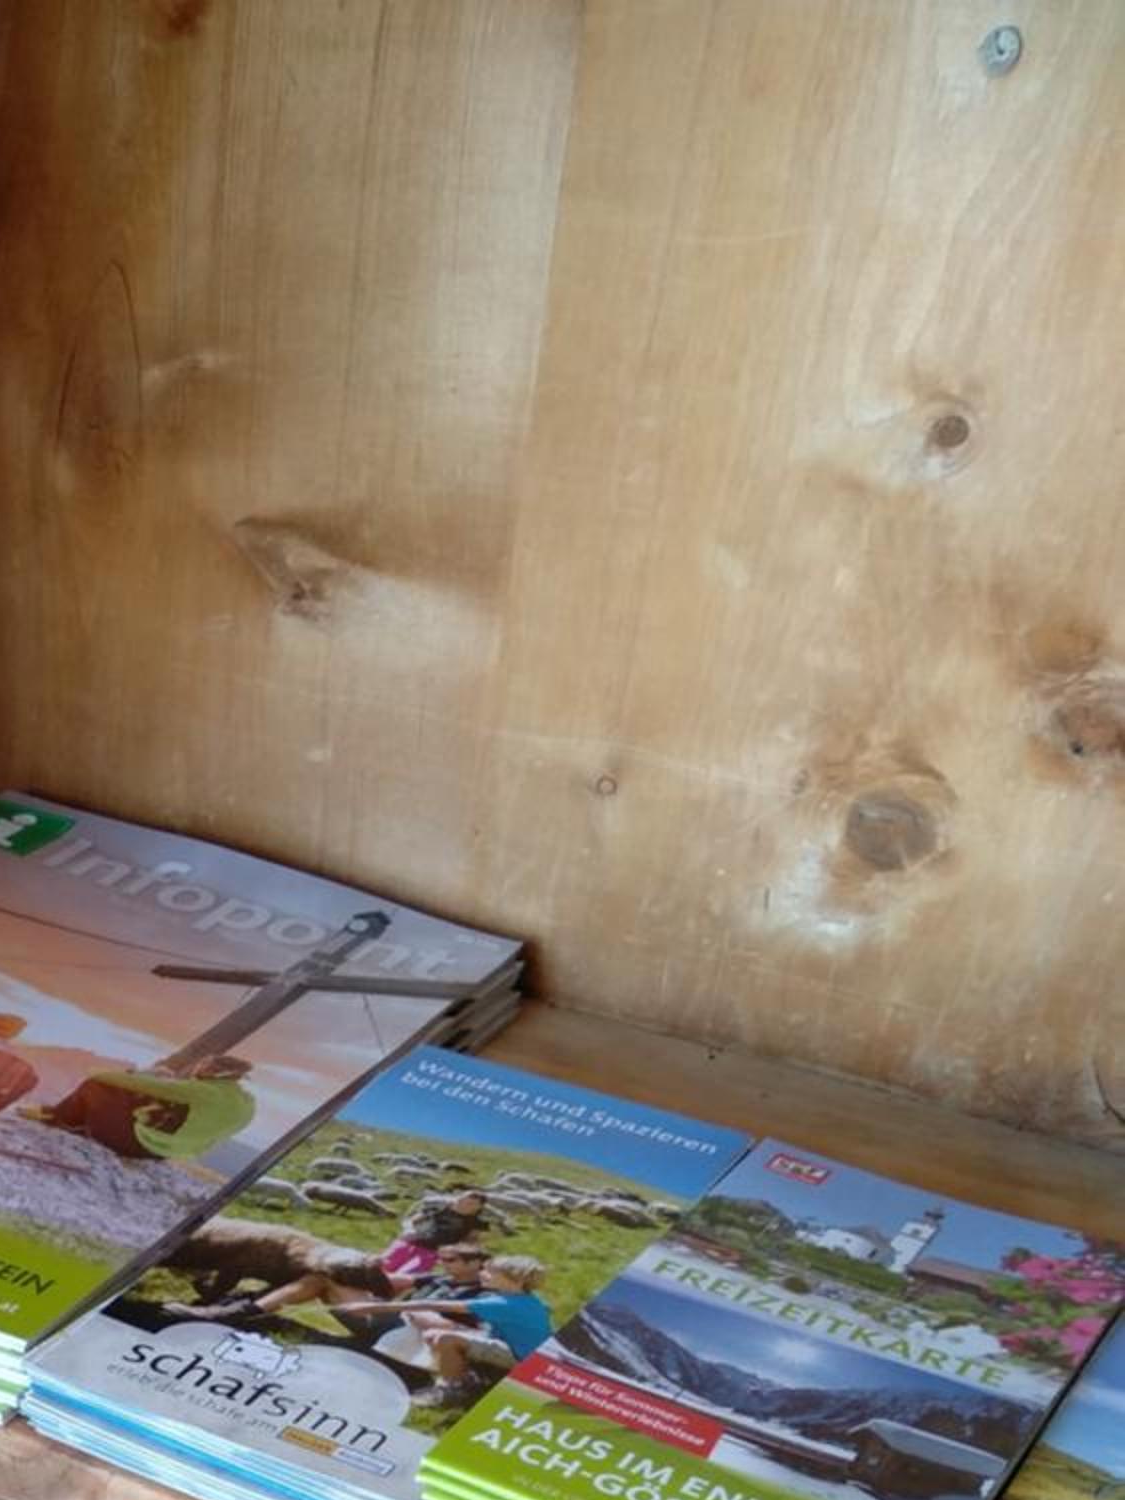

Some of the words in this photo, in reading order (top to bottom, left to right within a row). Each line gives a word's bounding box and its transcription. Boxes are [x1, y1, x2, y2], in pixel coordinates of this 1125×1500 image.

[400, 1071, 439, 1092] bei
[442, 1084, 492, 1107] den
[418, 1059, 528, 1101] Wandern
[535, 1094, 586, 1119] und
[589, 1109, 719, 1156] Spazieren
[652, 1258, 1011, 1389] FREIZEITKARTE
[122, 1342, 389, 1453] schafsinn
[492, 1406, 615, 1461] HAUS
[618, 1452, 675, 1486] IM
